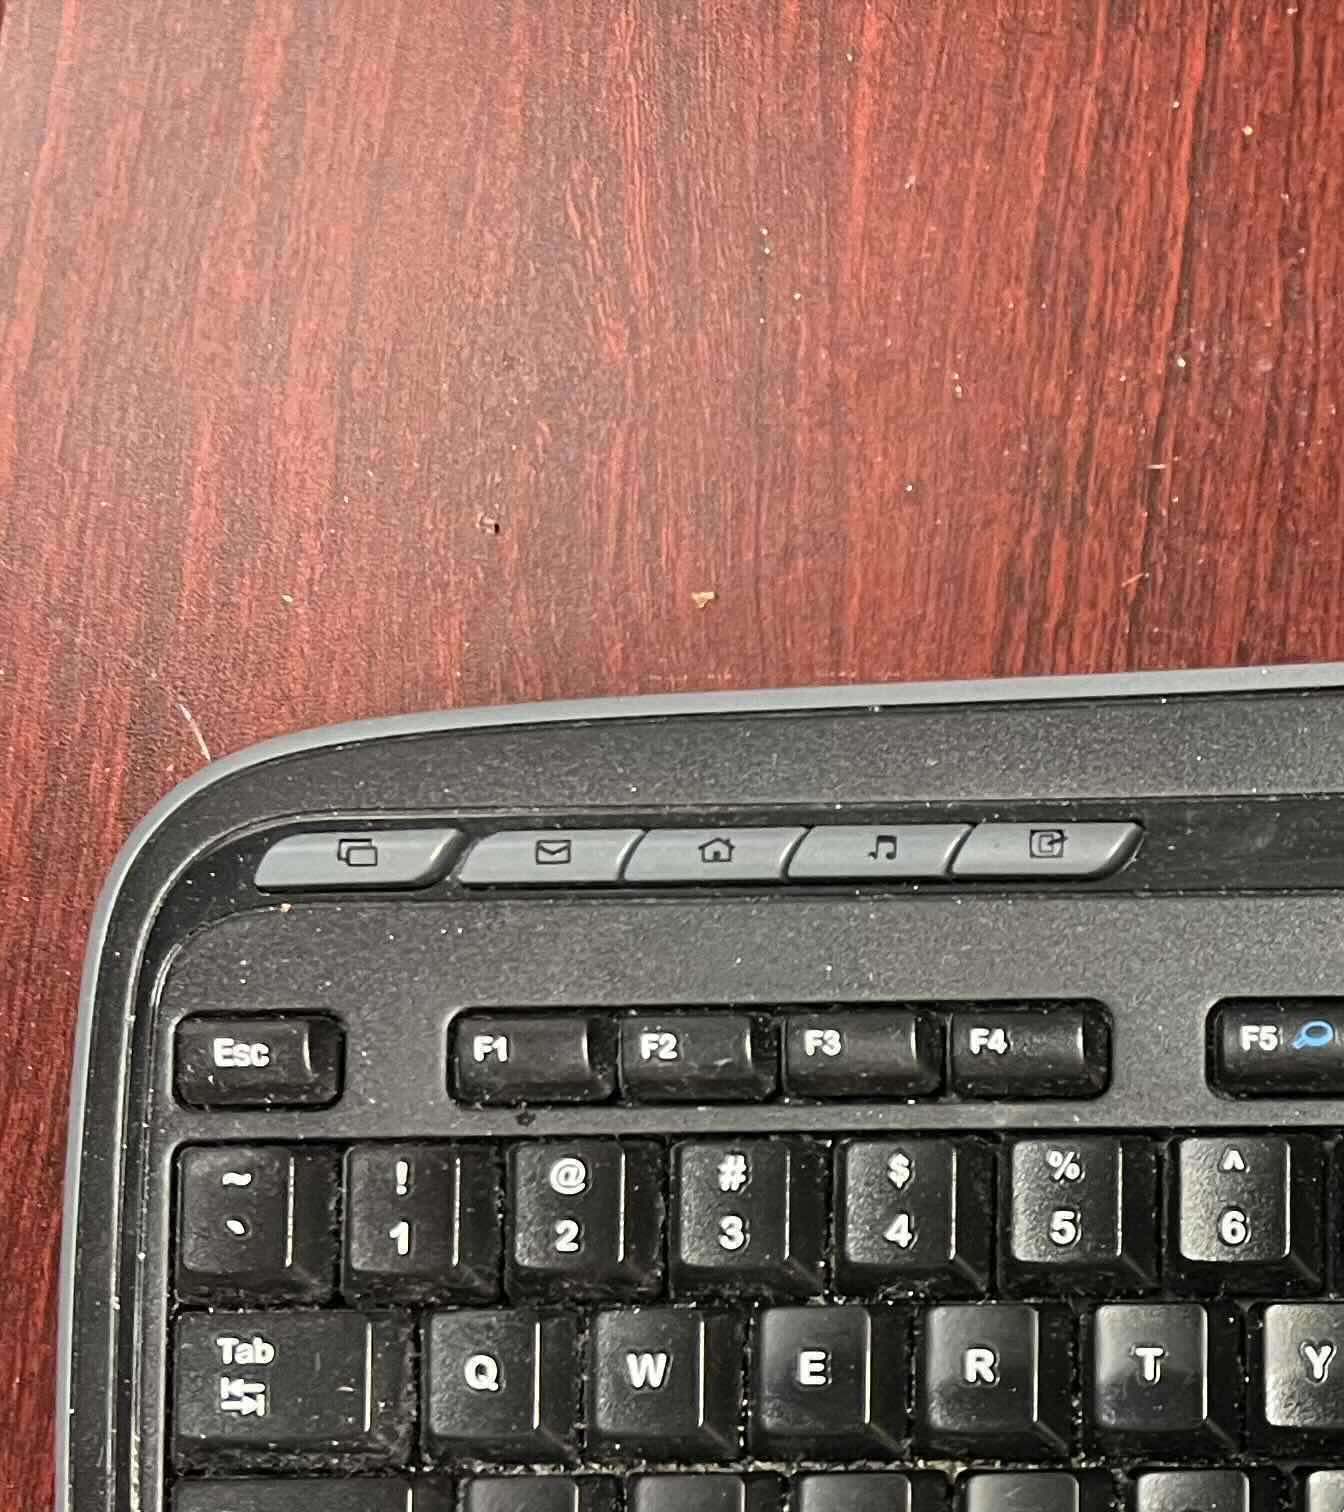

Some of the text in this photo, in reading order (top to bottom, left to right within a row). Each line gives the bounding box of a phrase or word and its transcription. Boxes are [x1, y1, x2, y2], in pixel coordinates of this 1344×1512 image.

[474, 1037, 508, 1060] F1
[640, 1034, 677, 1060] F2
[805, 1030, 841, 1055] F3
[970, 1028, 1006, 1054] F4
[1242, 1026, 1278, 1050] F5
[214, 1040, 270, 1067] Esc
[550, 1159, 586, 1193] @
[718, 1159, 746, 1190] #
[890, 1154, 911, 1189] $
[1049, 1152, 1081, 1182] %
[1221, 1151, 1245, 1171] ^
[222, 1171, 252, 1185] ~
[396, 1162, 407, 1194] !
[390, 1221, 408, 1253] 1
[555, 1221, 578, 1251] 2
[720, 1217, 744, 1247] 3
[886, 1216, 912, 1246] 4
[1051, 1212, 1077, 1243] 5
[1221, 1210, 1247, 1243] 6
[218, 1338, 274, 1365] Tab
[966, 1348, 996, 1382] R
[1136, 1347, 1165, 1380] T
[1304, 1344, 1336, 1377] Y
[465, 1355, 499, 1390] Q
[627, 1354, 667, 1386] W
[801, 1352, 826, 1384] E
